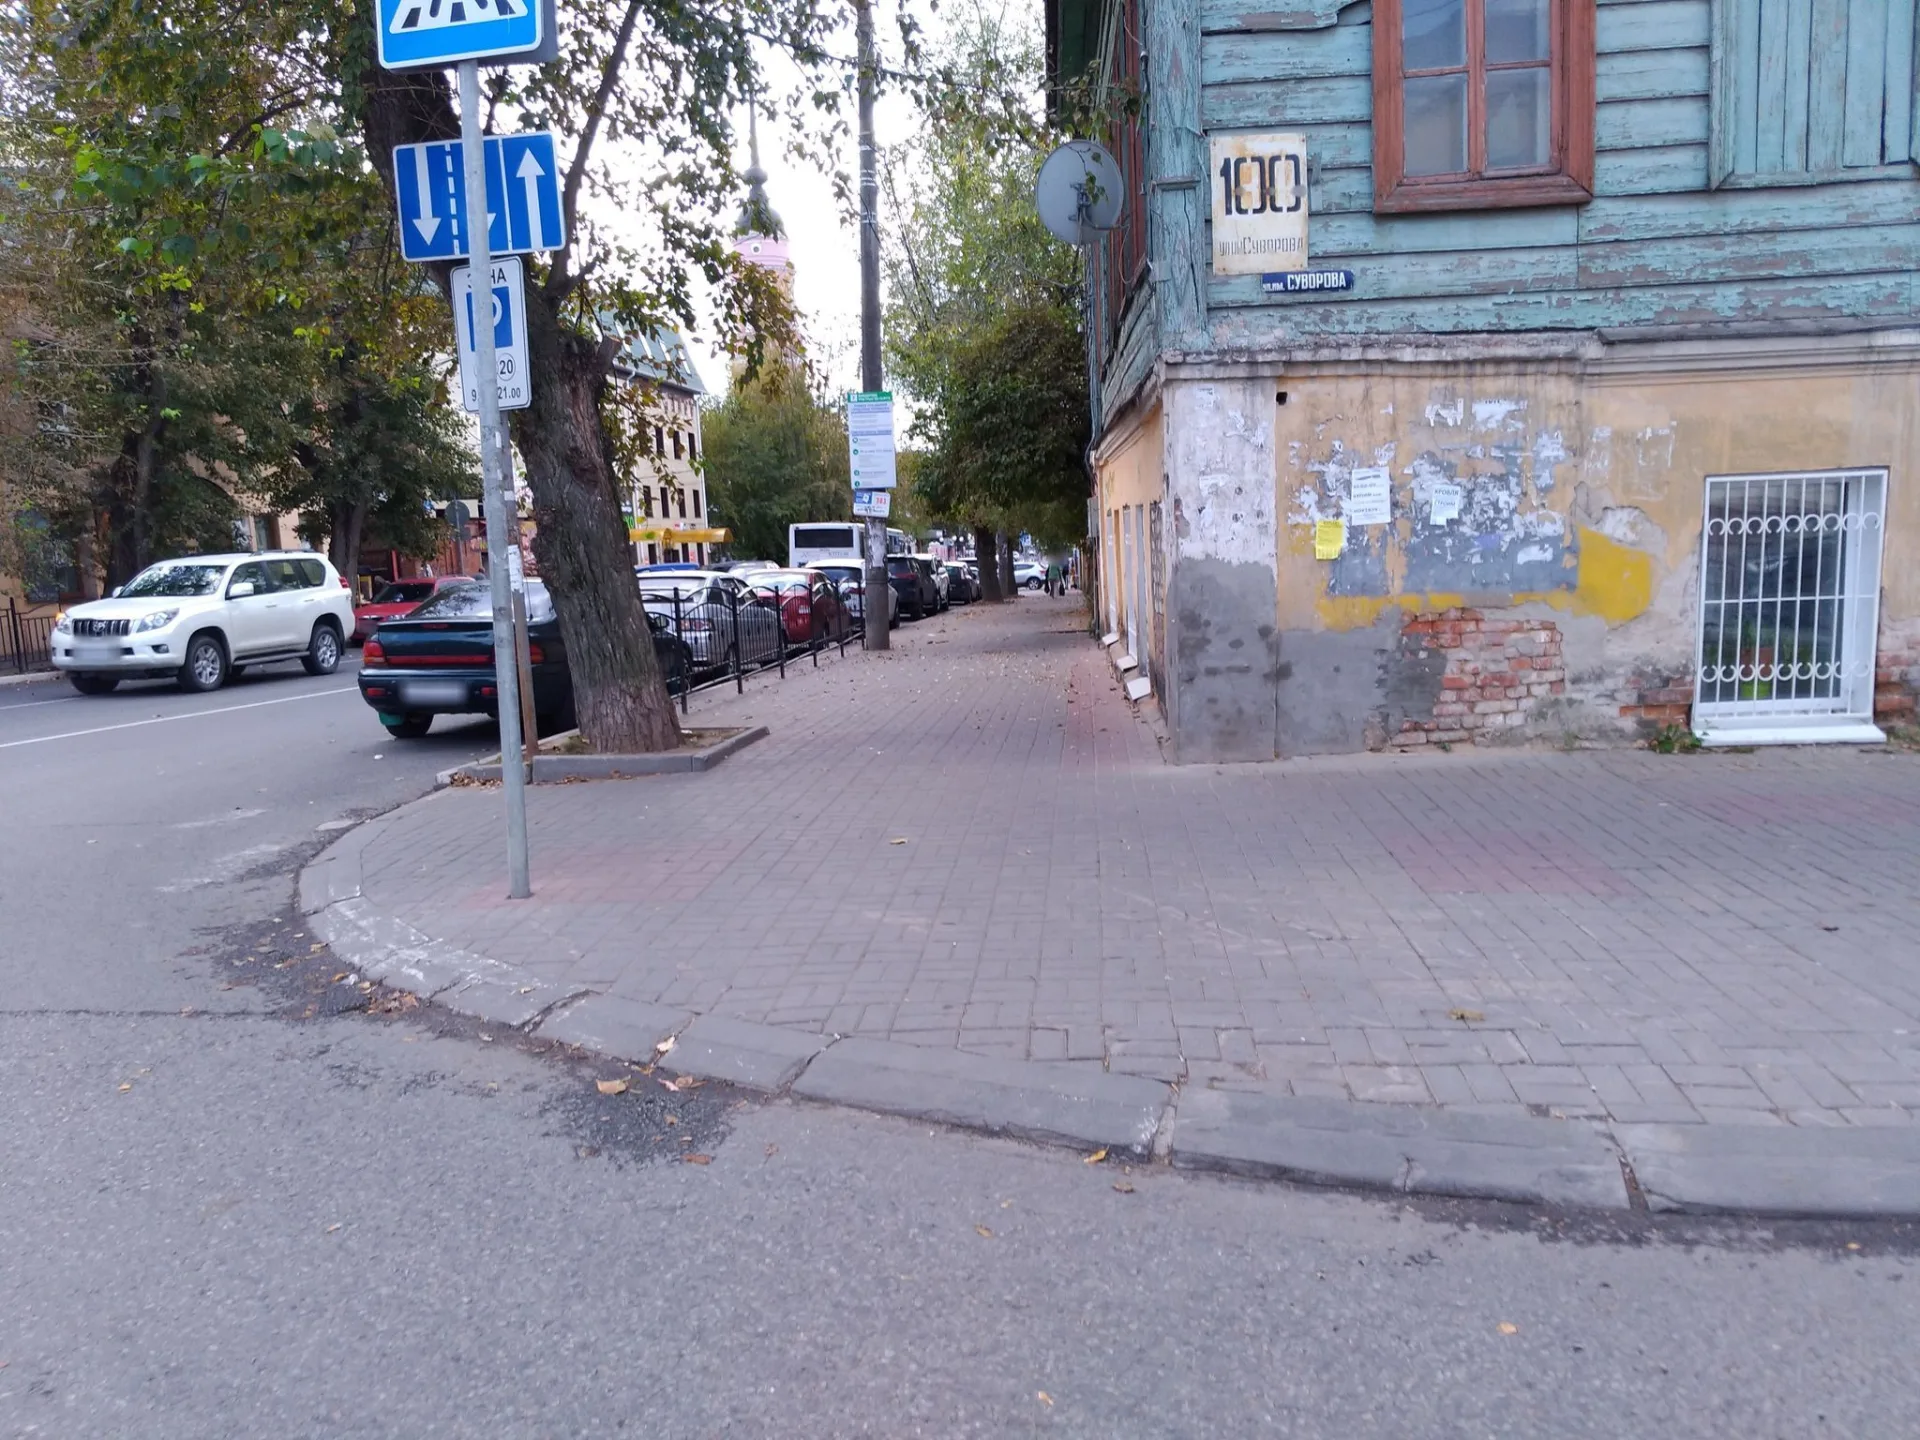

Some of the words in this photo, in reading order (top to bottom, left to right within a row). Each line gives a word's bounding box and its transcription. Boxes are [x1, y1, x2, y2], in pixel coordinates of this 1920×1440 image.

[1220, 154, 1302, 216] 100
[1287, 271, 1347, 291] СУВОРОВА
[499, 359, 514, 375] 20
